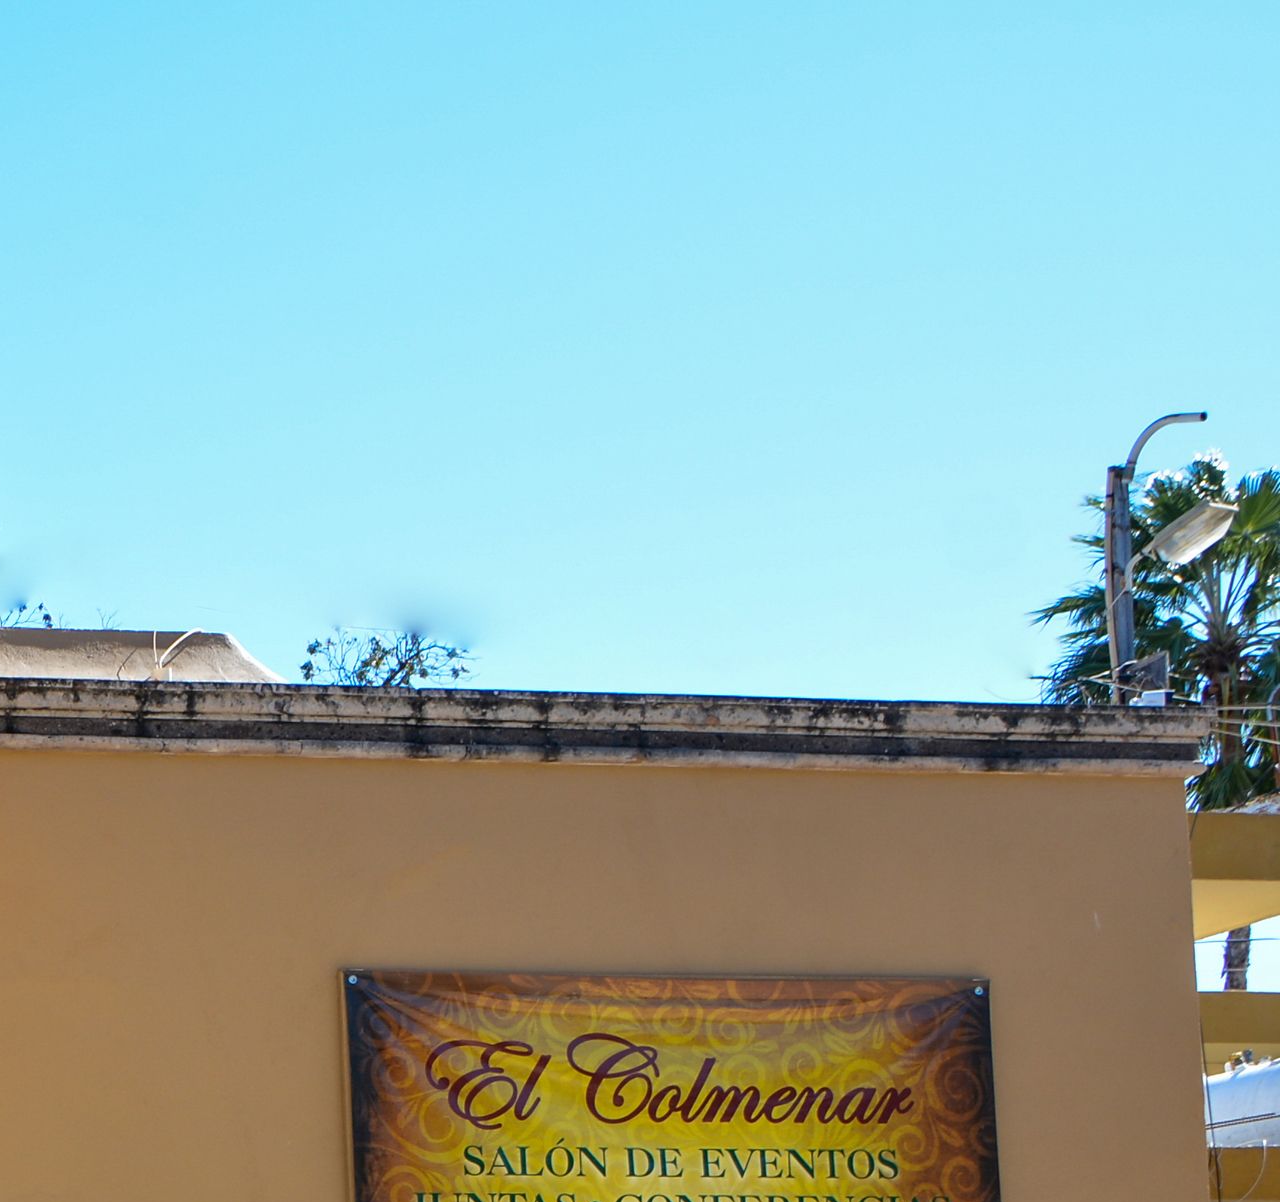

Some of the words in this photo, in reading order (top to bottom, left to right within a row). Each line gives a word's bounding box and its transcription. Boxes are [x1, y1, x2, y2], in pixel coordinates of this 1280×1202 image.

[425, 1038, 552, 1130] El
[566, 1032, 914, 1124] Colmenar
[462, 1137, 609, 1177] SALÓN
[625, 1147, 683, 1178] DE
[700, 1148, 899, 1180] EVENTOS
